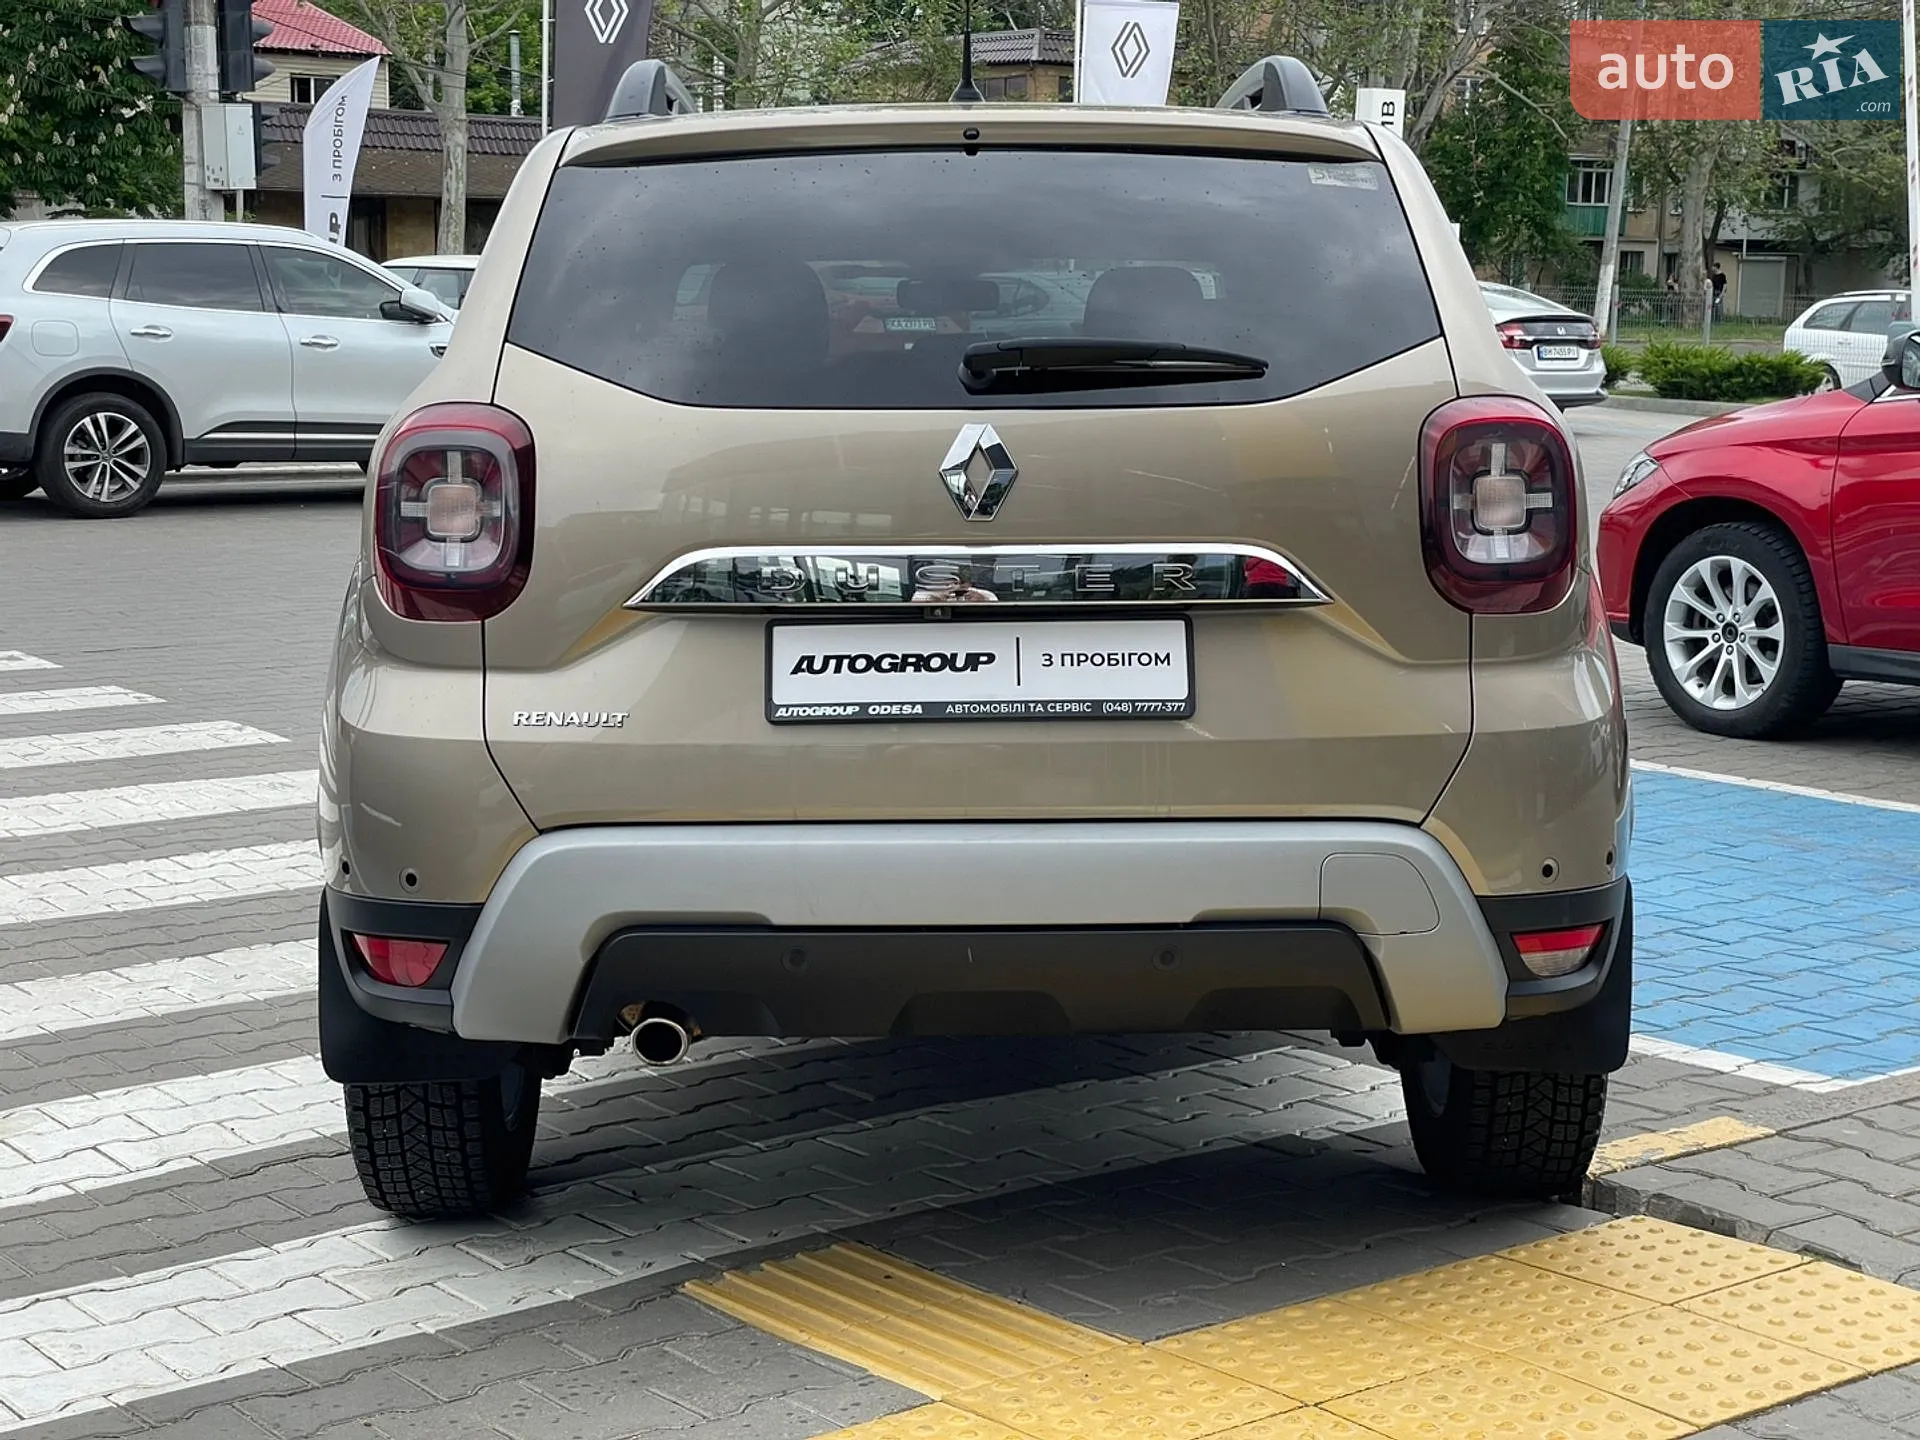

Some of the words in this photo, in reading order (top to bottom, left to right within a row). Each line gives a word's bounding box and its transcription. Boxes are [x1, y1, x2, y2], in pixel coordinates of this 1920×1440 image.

[332, 95, 348, 169] ПРОБІГОМ
[757, 563, 1196, 593] DUSTER
[790, 652, 996, 676] AUTOGROUP
[1060, 652, 1171, 667] ПРОБІГОМ
[775, 705, 860, 718] AUTOGROUP
[868, 704, 923, 715] ODESA
[945, 702, 1026, 715] АВТОМОБІЛІ
[1028, 702, 1045, 713] ТА
[1046, 701, 1093, 713] СЕРВІС
[1102, 701, 1133, 714] (048)
[1134, 701, 1187, 713] 7777-377
[513, 711, 630, 728] RENAULT
